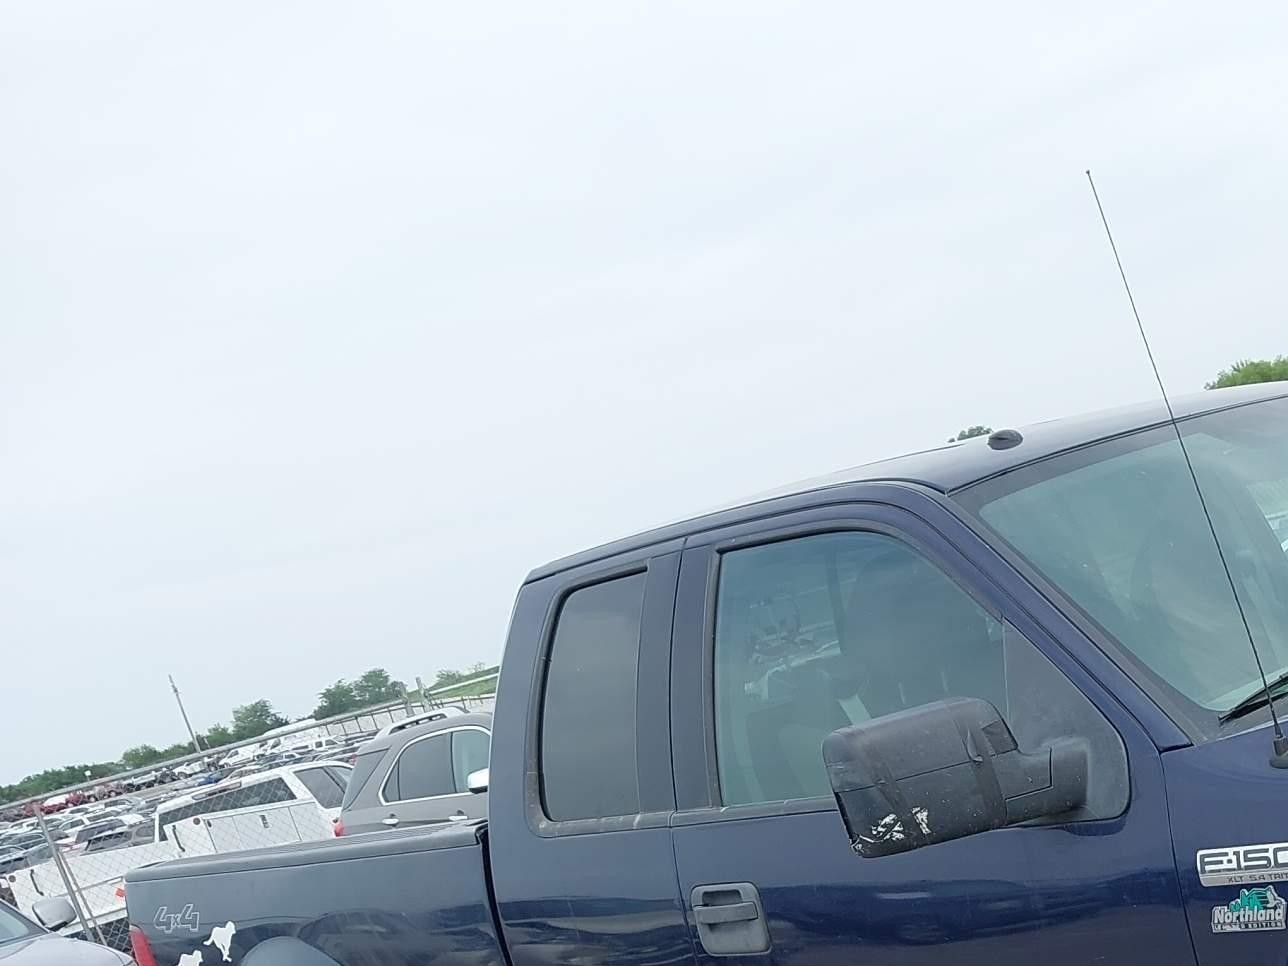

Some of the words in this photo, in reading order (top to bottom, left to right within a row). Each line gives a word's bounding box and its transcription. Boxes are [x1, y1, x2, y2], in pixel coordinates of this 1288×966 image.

[1227, 875, 1244, 883] XLT
[153, 904, 200, 934] 4x4
[1214, 905, 1283, 924] Northland
